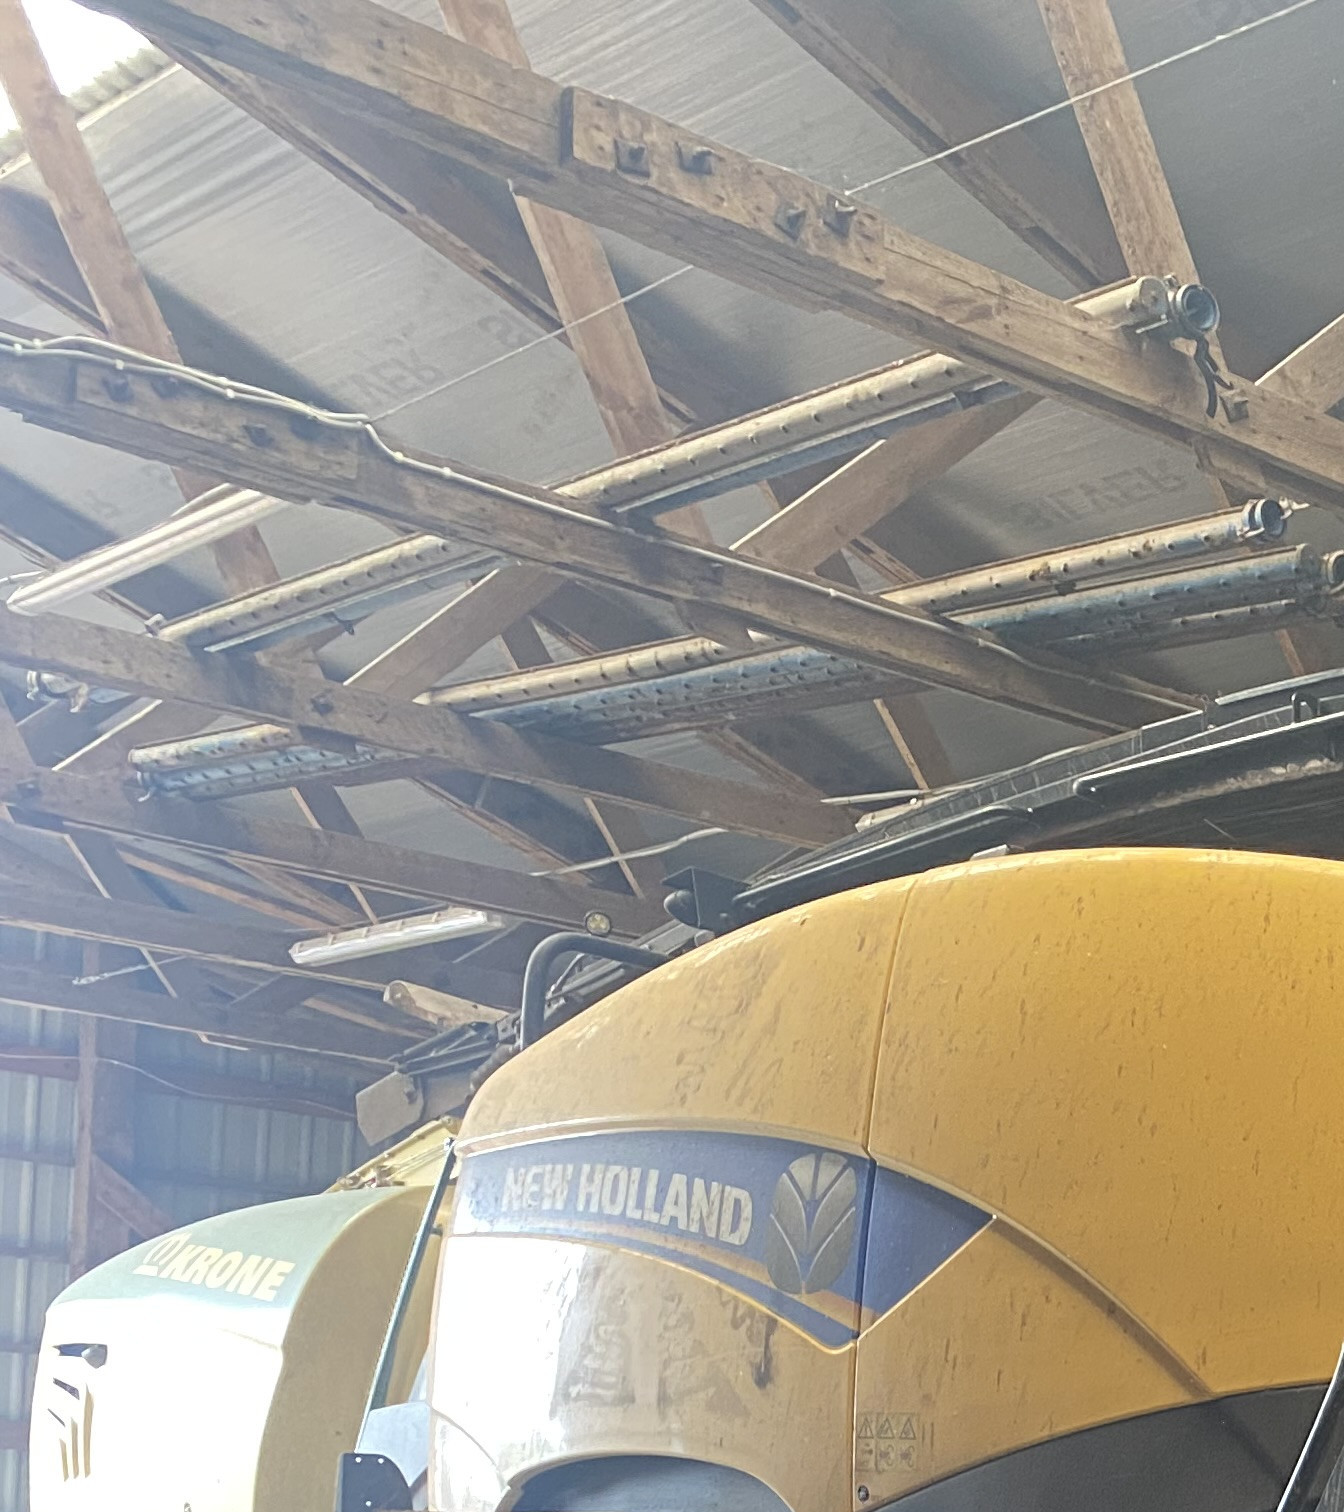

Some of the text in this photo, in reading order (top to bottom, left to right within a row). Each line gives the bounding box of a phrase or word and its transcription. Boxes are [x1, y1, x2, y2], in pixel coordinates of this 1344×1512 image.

[502, 1162, 753, 1247] NEW HOLLAND
[159, 1242, 296, 1302] KRONE
